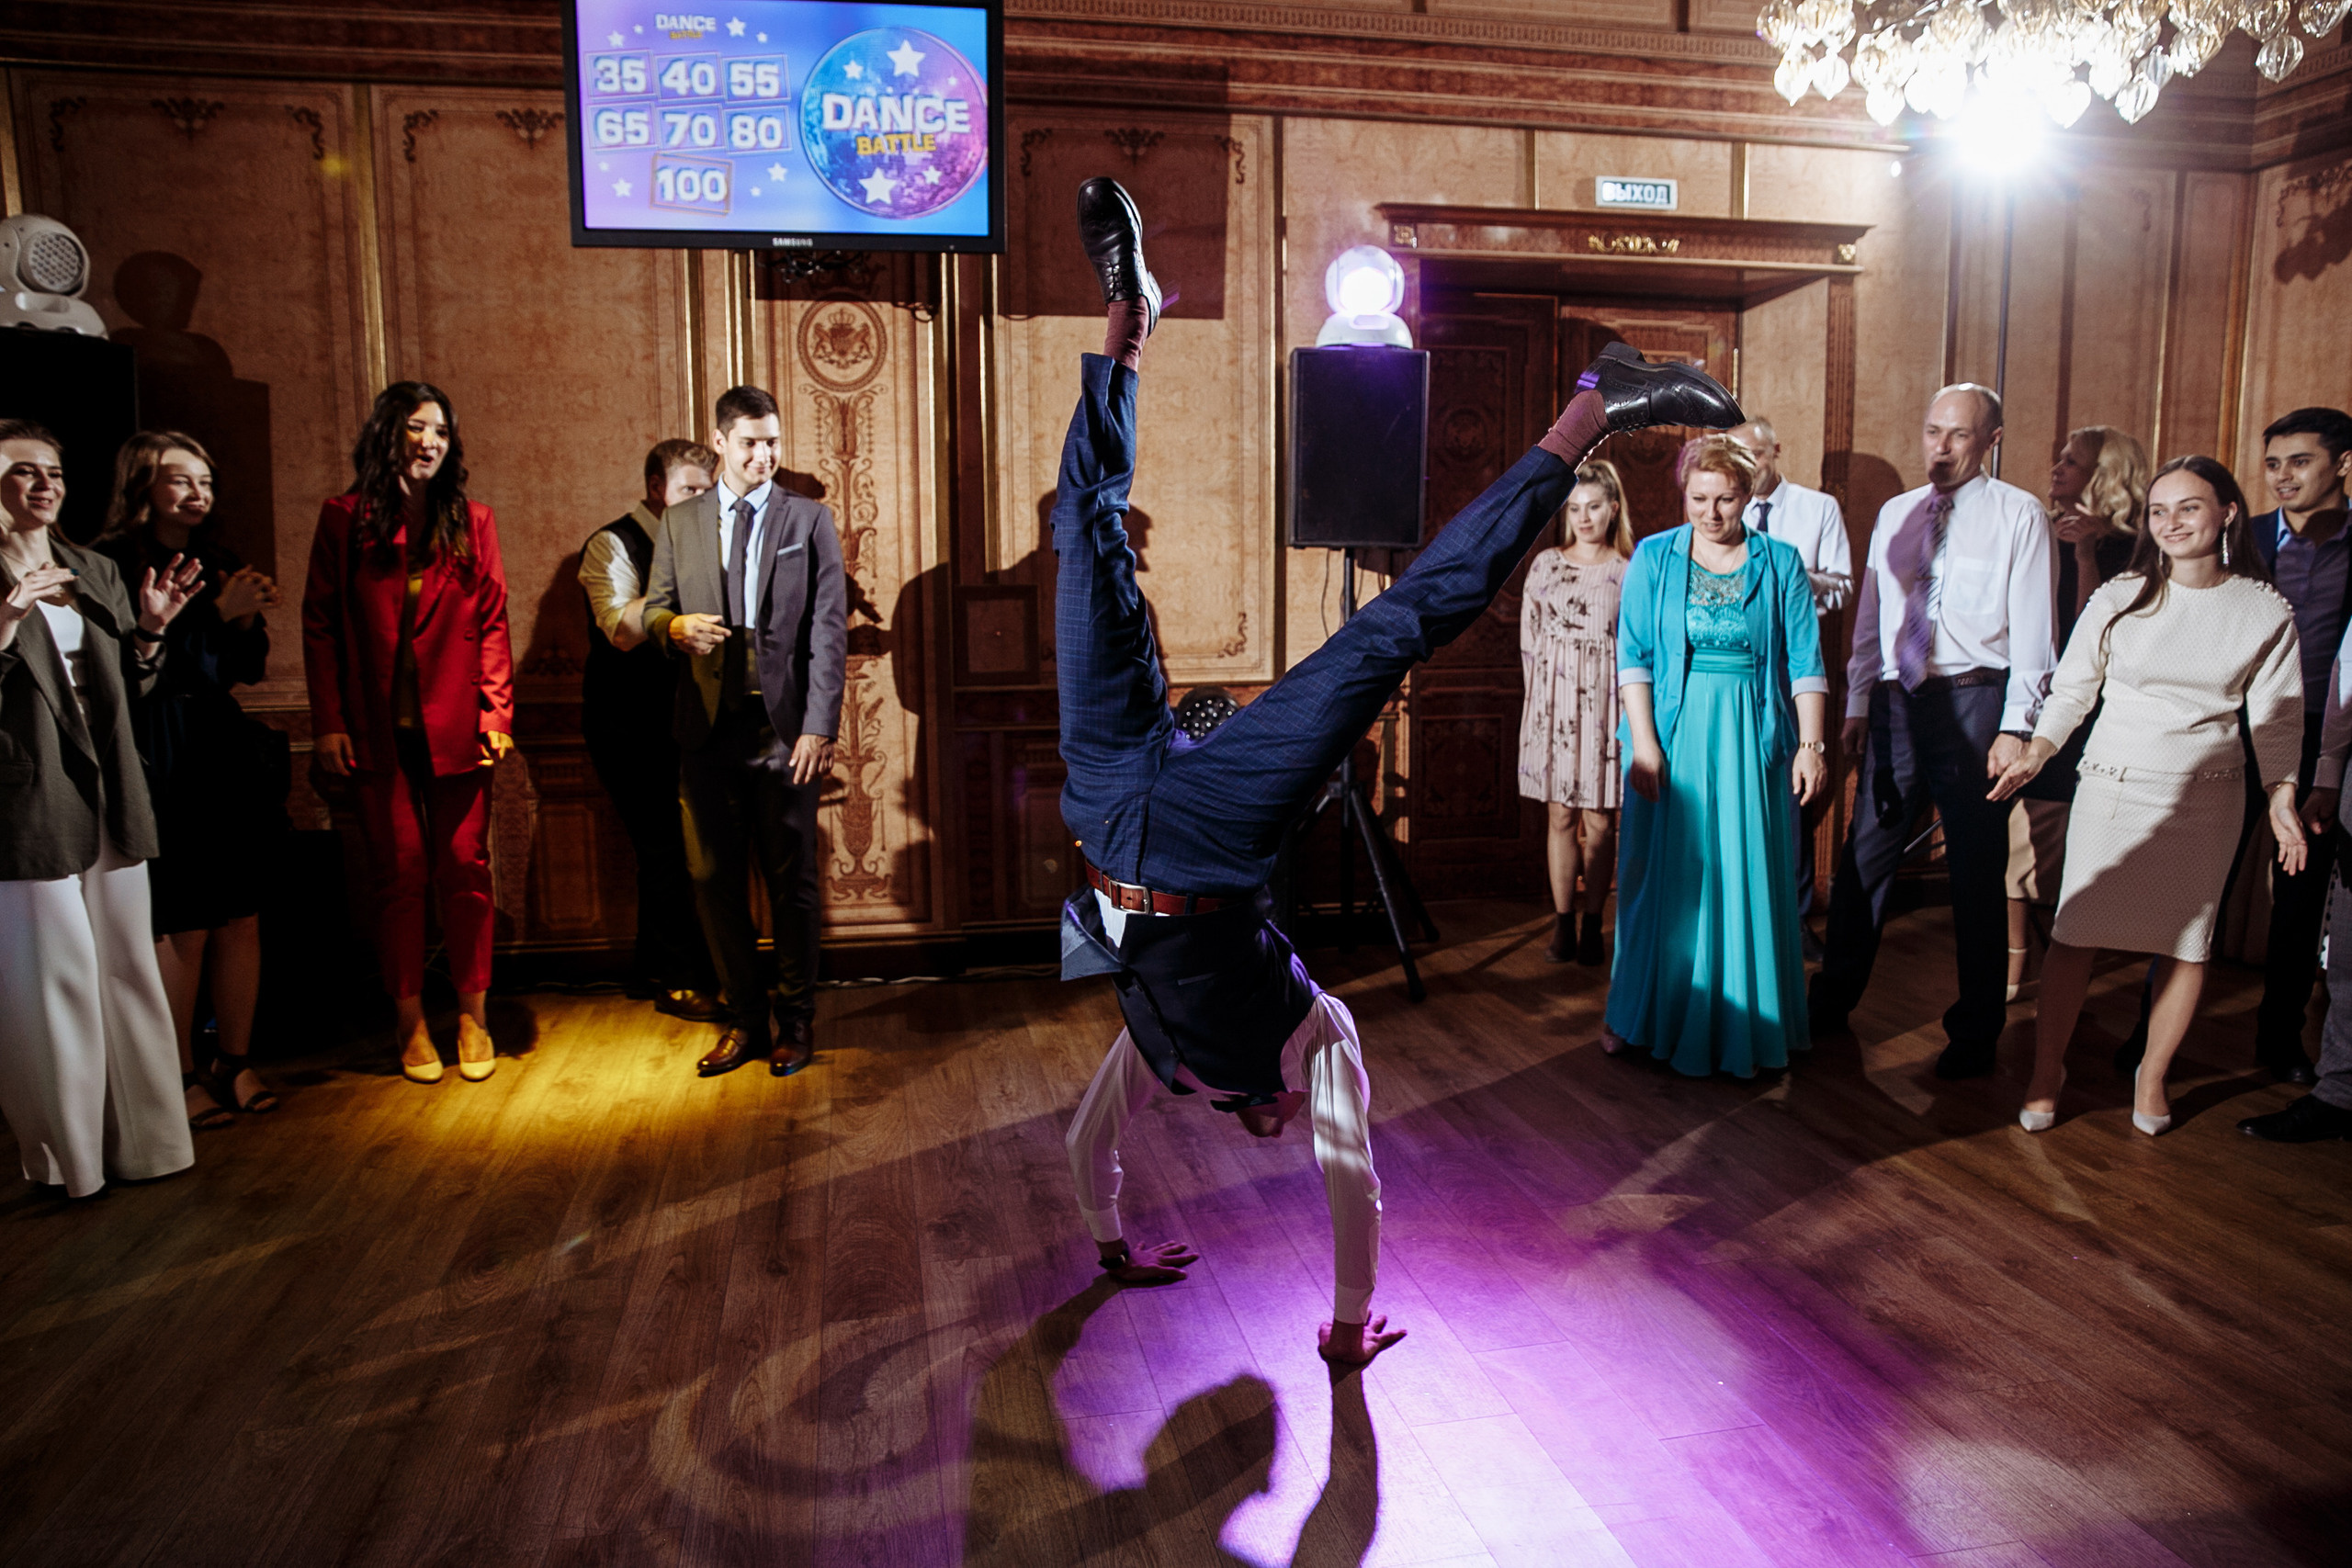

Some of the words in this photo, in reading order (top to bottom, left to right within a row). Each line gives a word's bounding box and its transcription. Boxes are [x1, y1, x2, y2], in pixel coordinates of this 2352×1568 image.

[656, 14, 716, 31] DANCE
[594, 57, 647, 93] 35
[661, 60, 717, 96] 40
[729, 62, 780, 97] 55
[821, 93, 971, 134] DANCE
[596, 111, 650, 146] 65
[663, 112, 717, 148] 70
[730, 115, 783, 149] 80
[855, 133, 937, 156] BATTLE
[656, 166, 729, 202] 100
[1602, 182, 1668, 204] ВЫХОД
[772, 237, 814, 247] SAMSUNG
